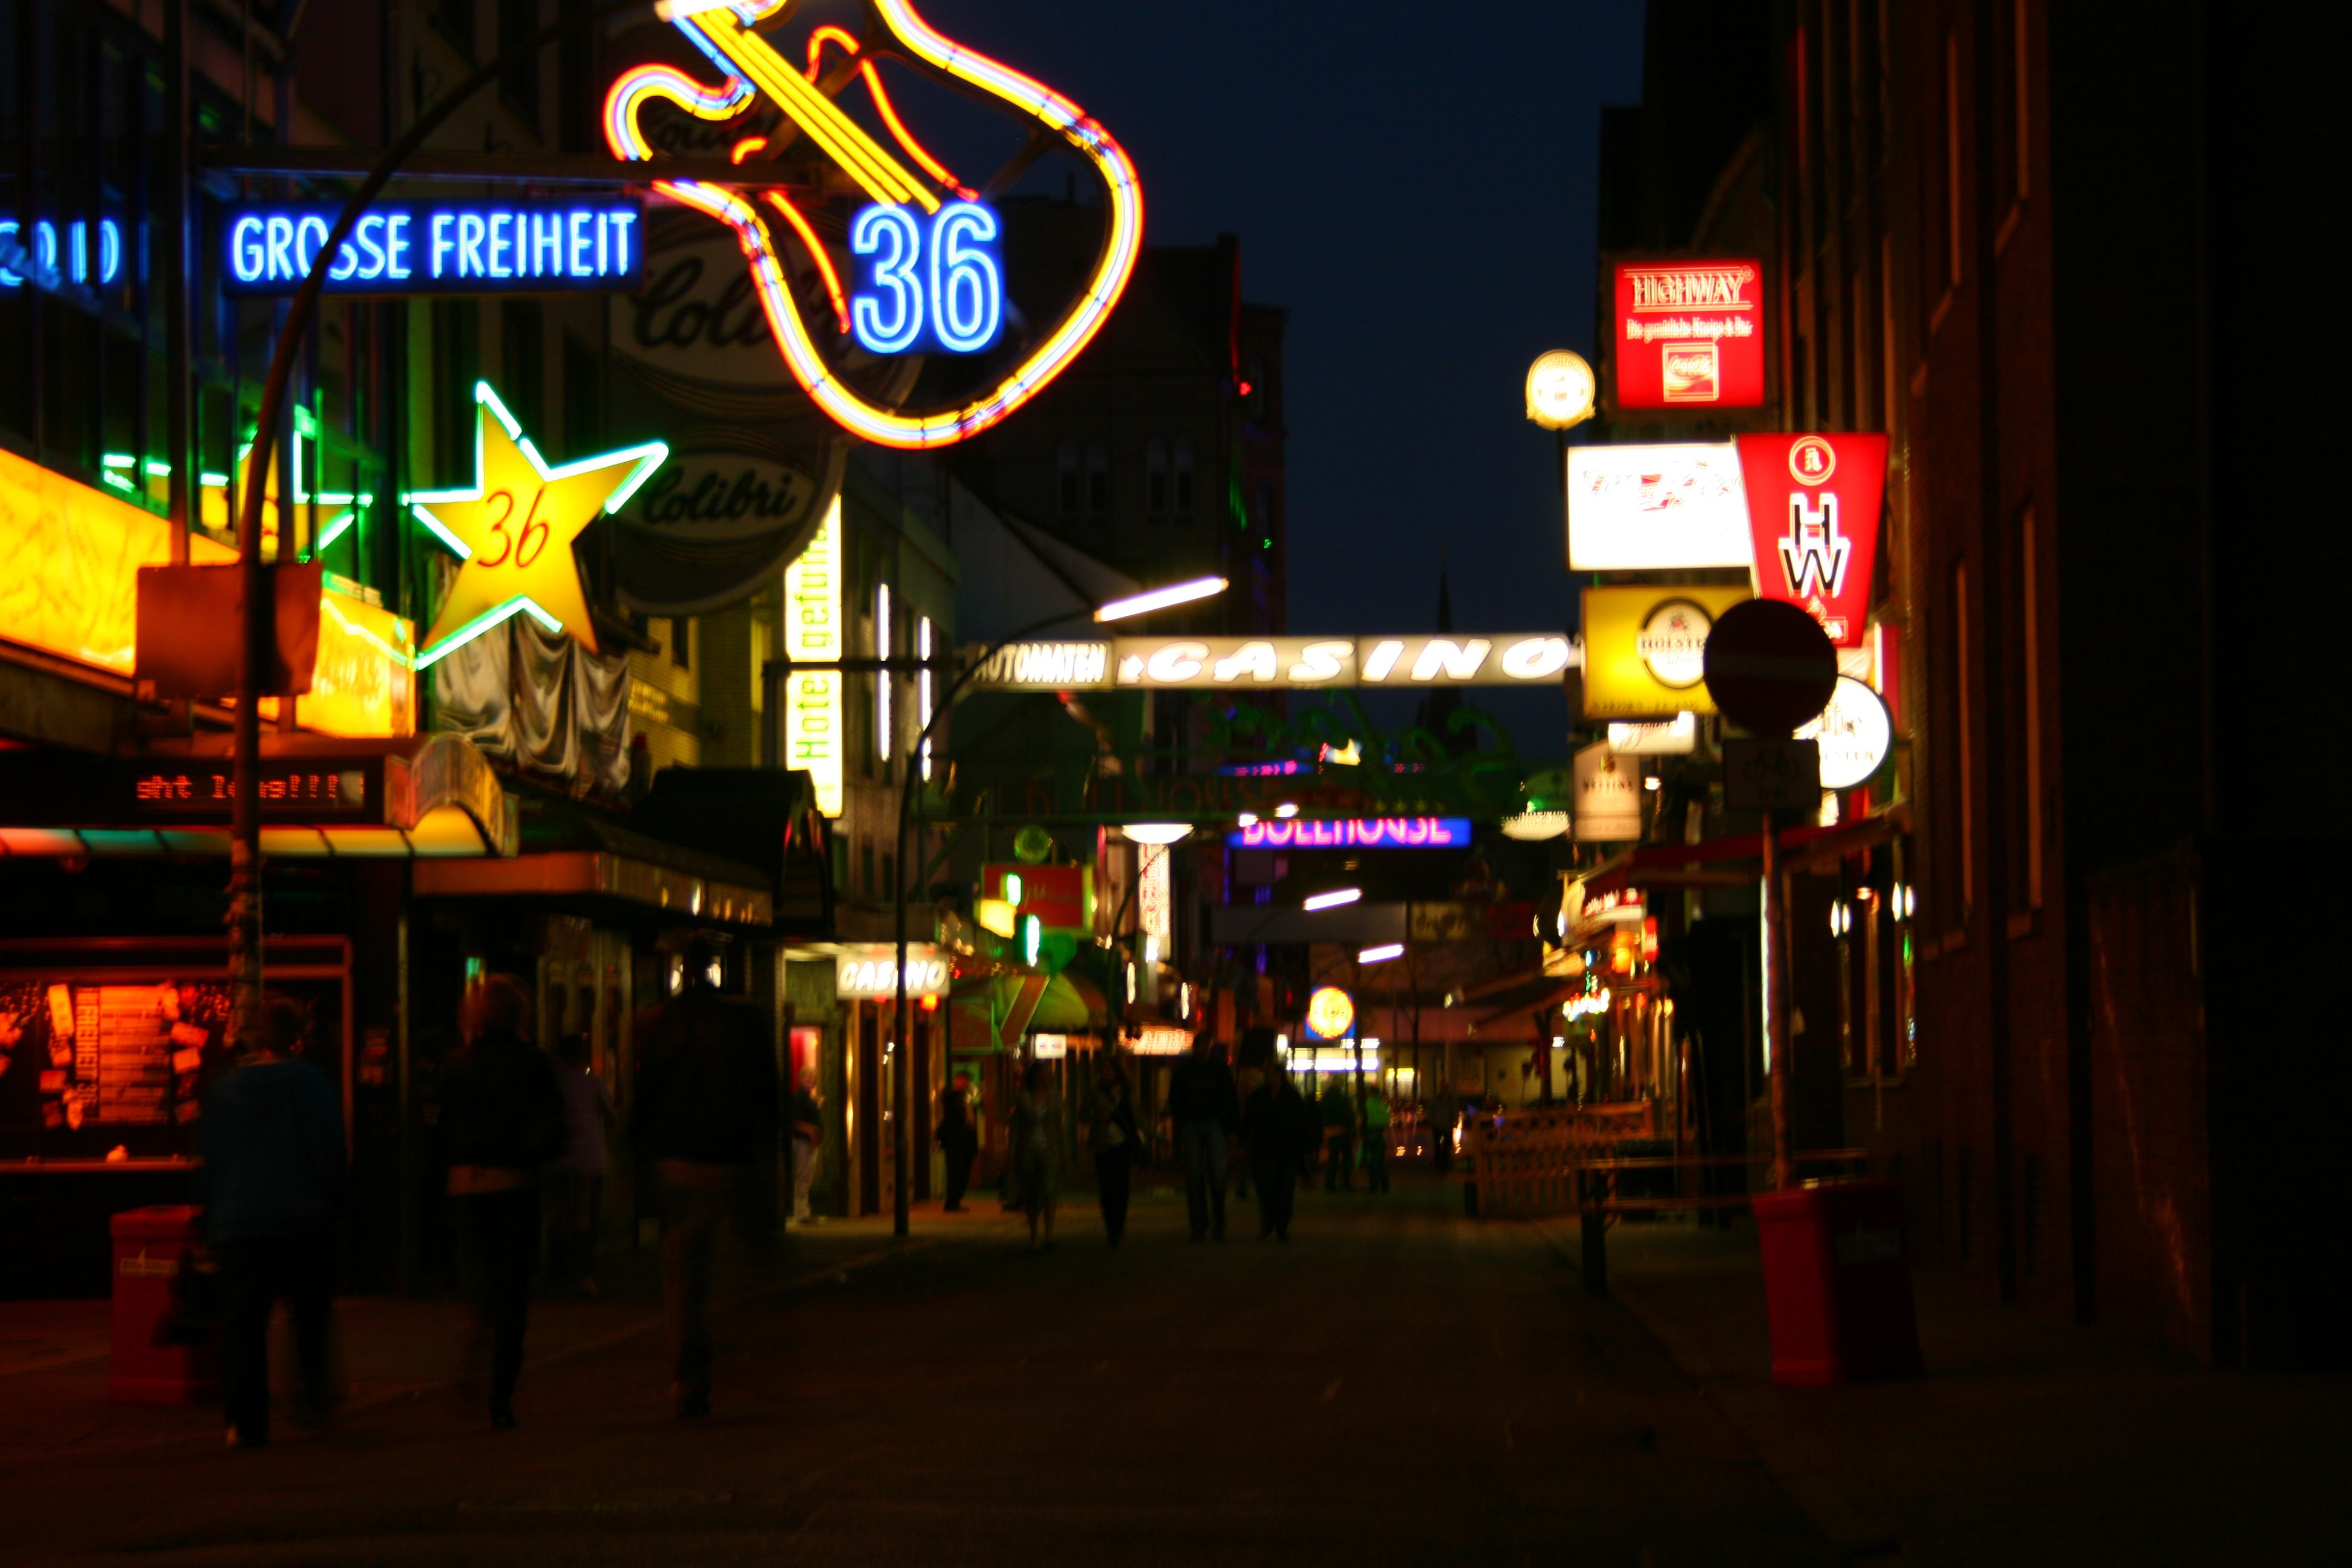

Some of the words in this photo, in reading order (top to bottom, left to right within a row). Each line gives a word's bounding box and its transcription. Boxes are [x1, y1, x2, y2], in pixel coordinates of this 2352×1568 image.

[431, 212, 637, 279] FREIHEIT
[854, 203, 1000, 354] 36
[1632, 273, 1745, 306] HIGHWAY
[477, 490, 549, 568] 36
[973, 643, 1107, 683] AUTOMATEN
[1147, 639, 1569, 682] CASINO
